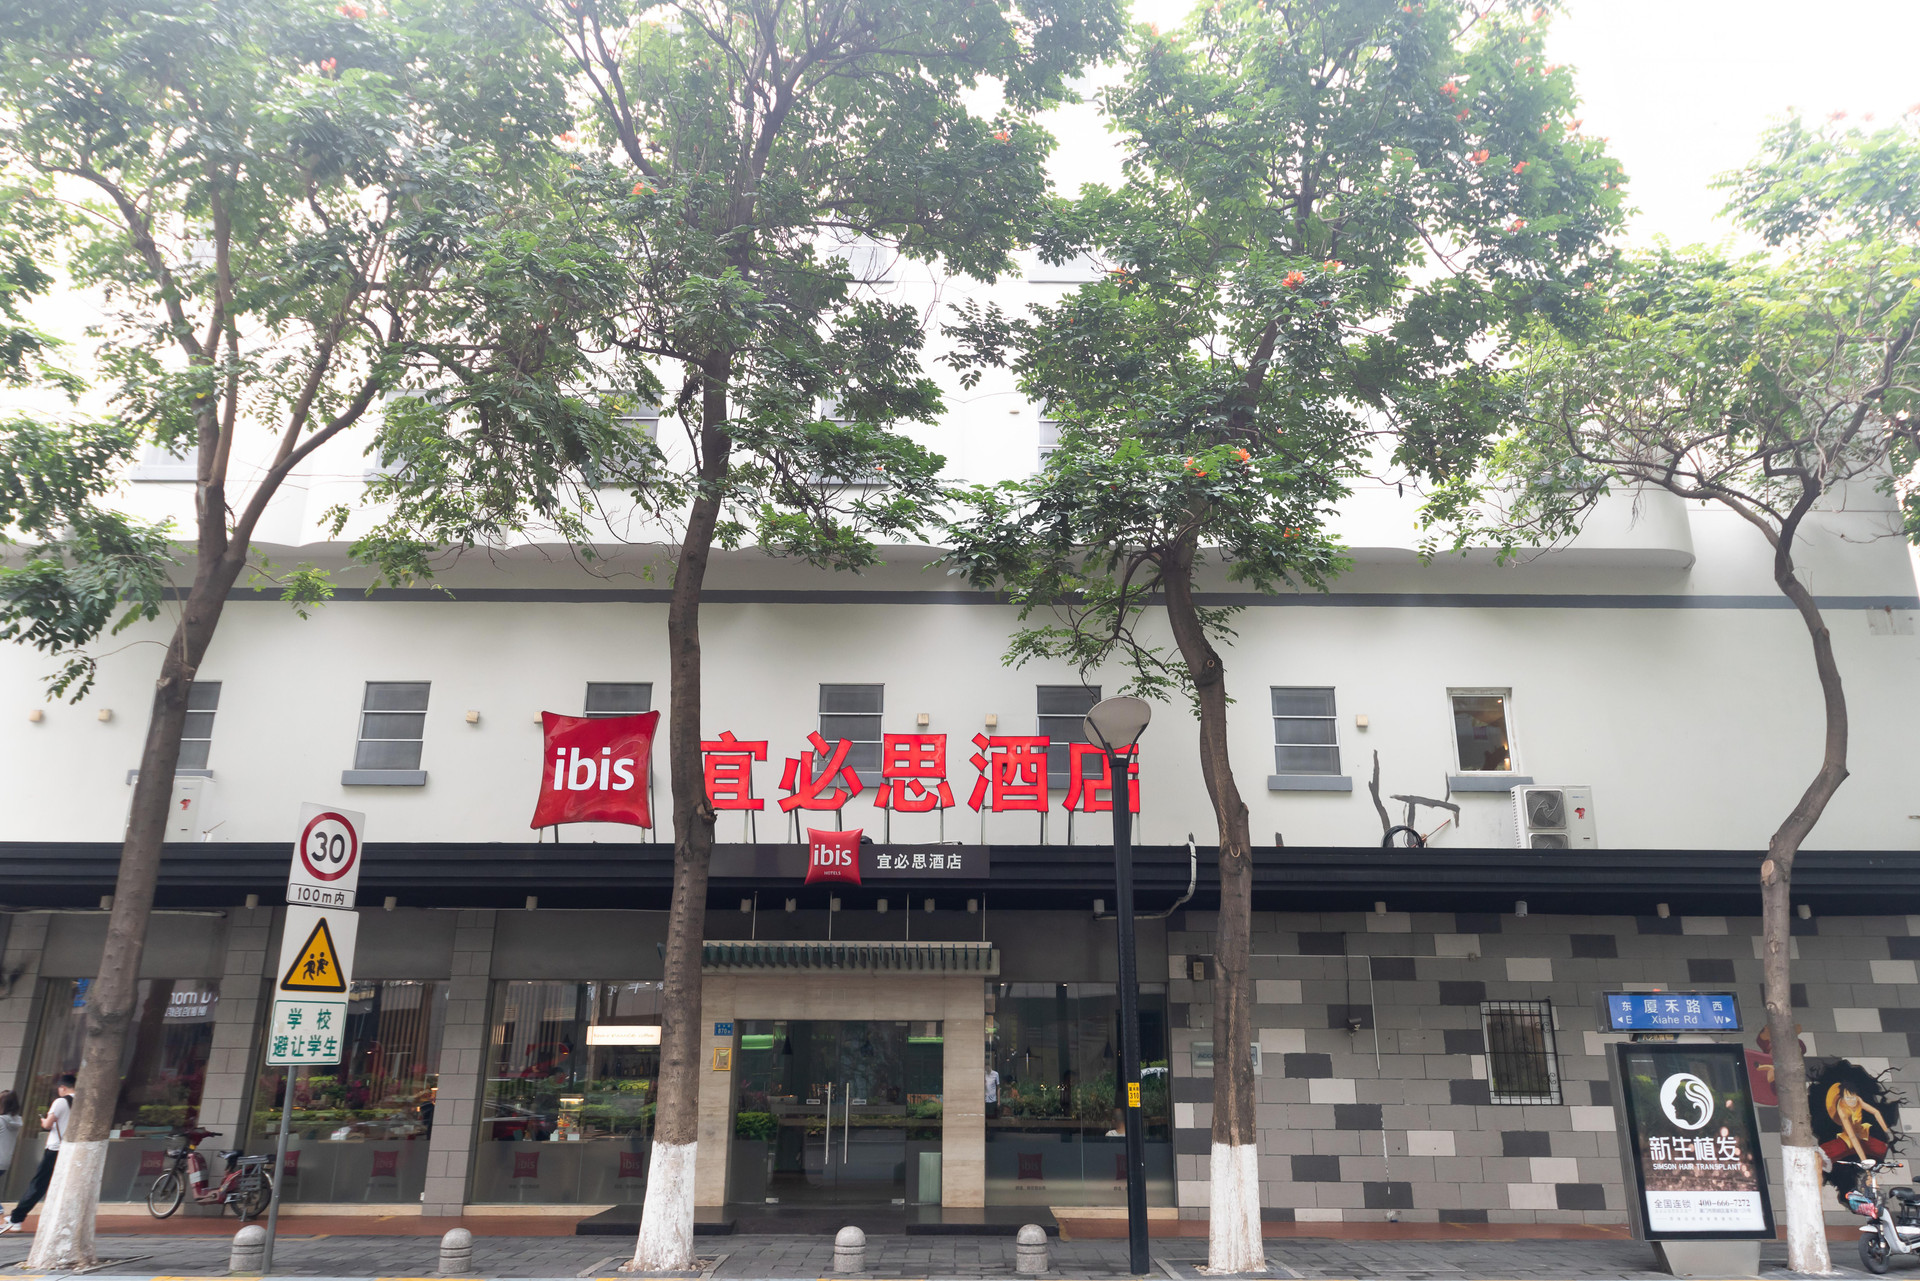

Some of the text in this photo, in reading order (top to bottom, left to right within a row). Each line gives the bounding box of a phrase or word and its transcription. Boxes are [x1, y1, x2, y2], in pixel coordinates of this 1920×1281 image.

[553, 747, 635, 791] ibis
[700, 730, 1140, 813] 宜必思酒店
[311, 831, 345, 864] 30
[813, 844, 852, 867] ibis
[877, 853, 962, 870] 宜必思酒店
[297, 887, 345, 906] 100m内
[1621, 999, 1723, 1014] 东 厦禾路 西
[1626, 1015, 1724, 1024] E Xiahe Rd W
[272, 1035, 338, 1058] 避让学生
[1649, 1136, 1740, 1161] 新生植发
[517, 1158, 536, 1169] ibis
[622, 1158, 641, 1169] ibis
[1696, 1163, 1741, 1171] TRANSPLANT
[1654, 1199, 1692, 1209] 全国连锁
[1698, 1199, 1751, 1207] 400-666-7272
